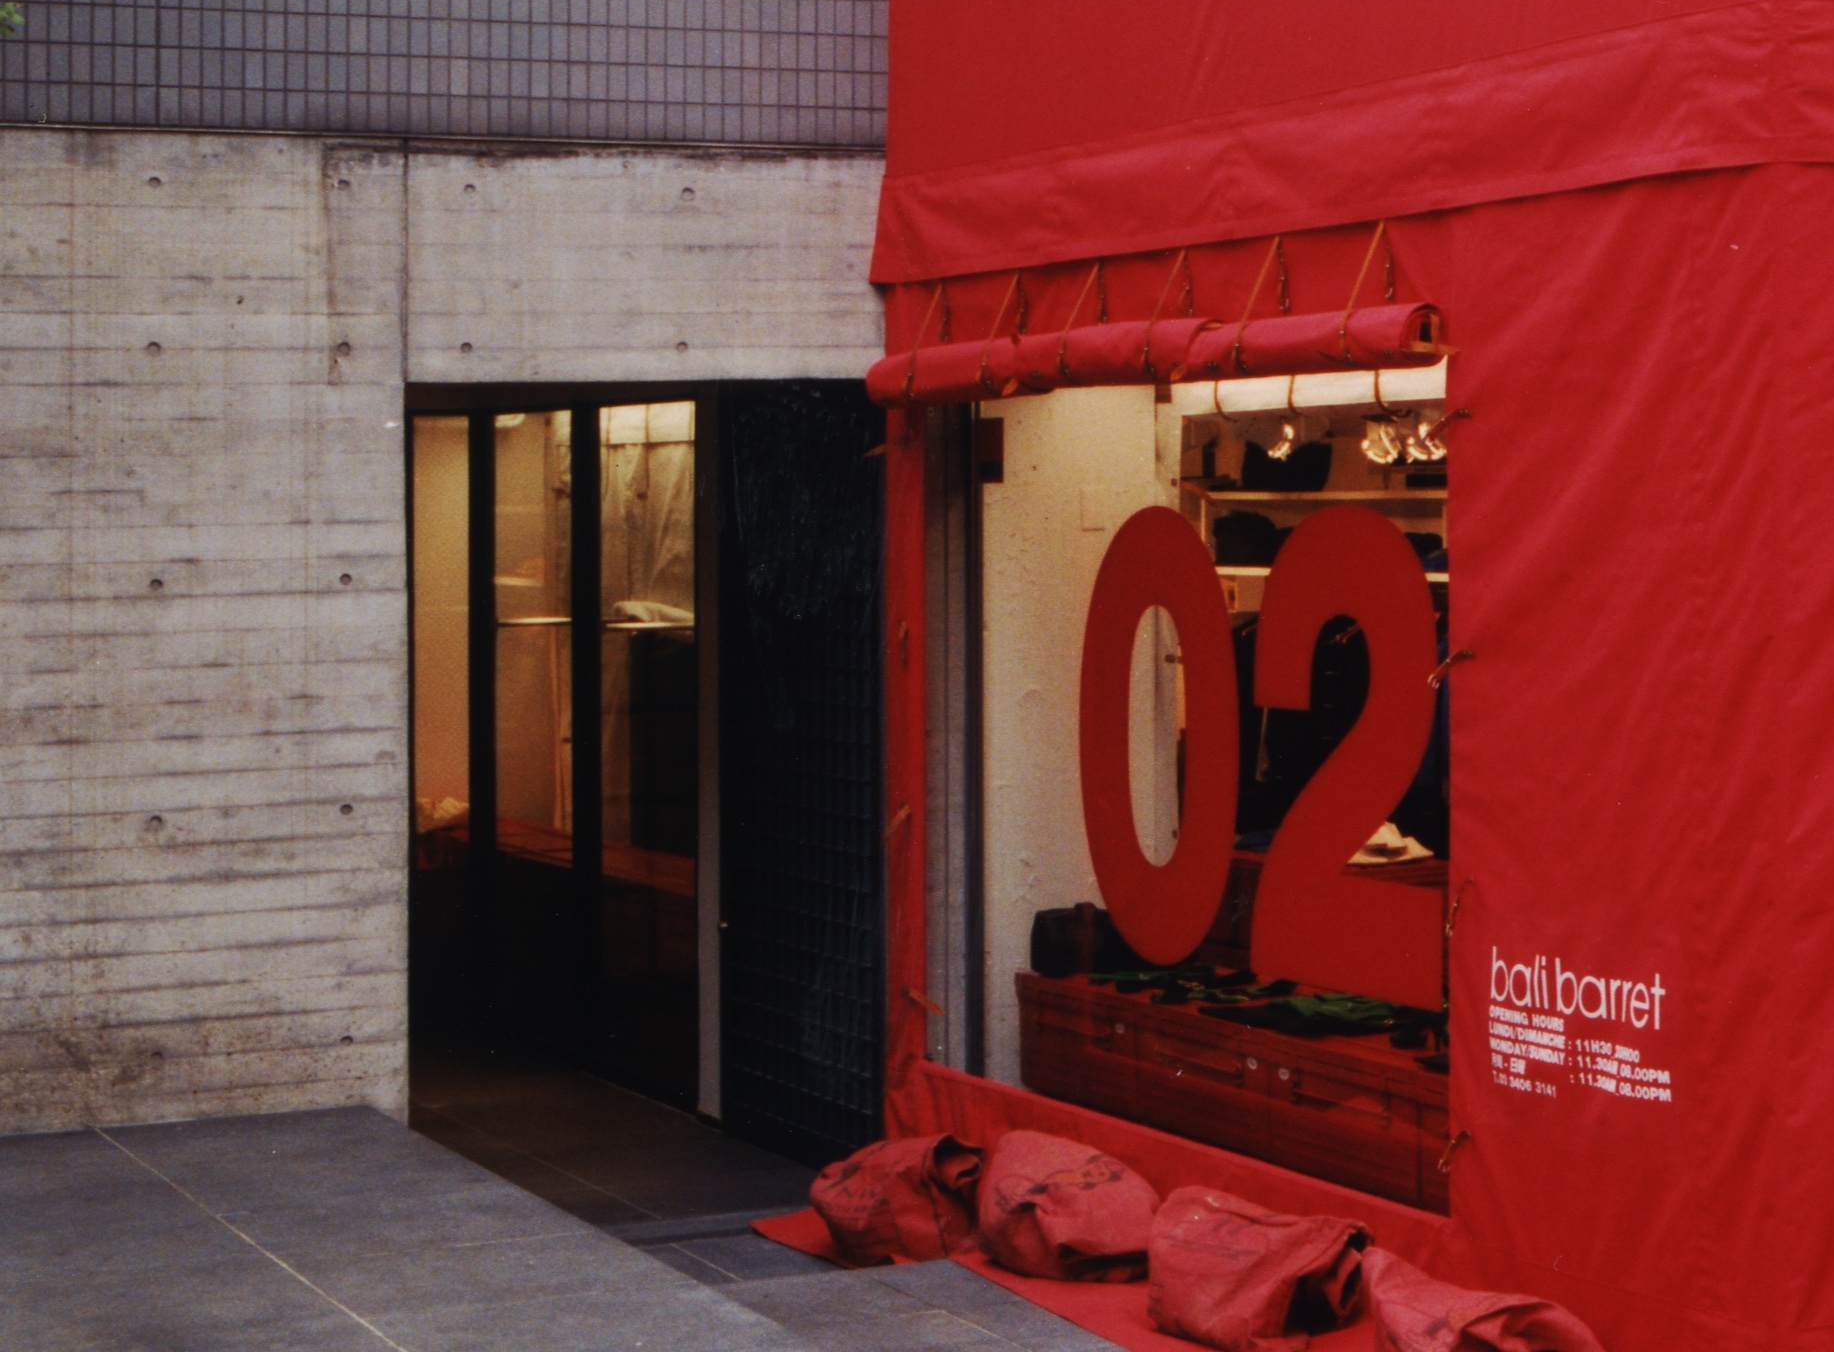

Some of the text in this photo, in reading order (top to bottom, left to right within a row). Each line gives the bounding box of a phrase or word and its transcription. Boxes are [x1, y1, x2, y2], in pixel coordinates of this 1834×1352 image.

[1079, 504, 1443, 1012] 02
[1490, 946, 1666, 1030] bali barret
[1489, 1005, 1564, 1032] OPENING HOURS
[1489, 1037, 1565, 1065] MONDAY/SUNDAY
[1535, 1081, 1556, 1098] 3141
